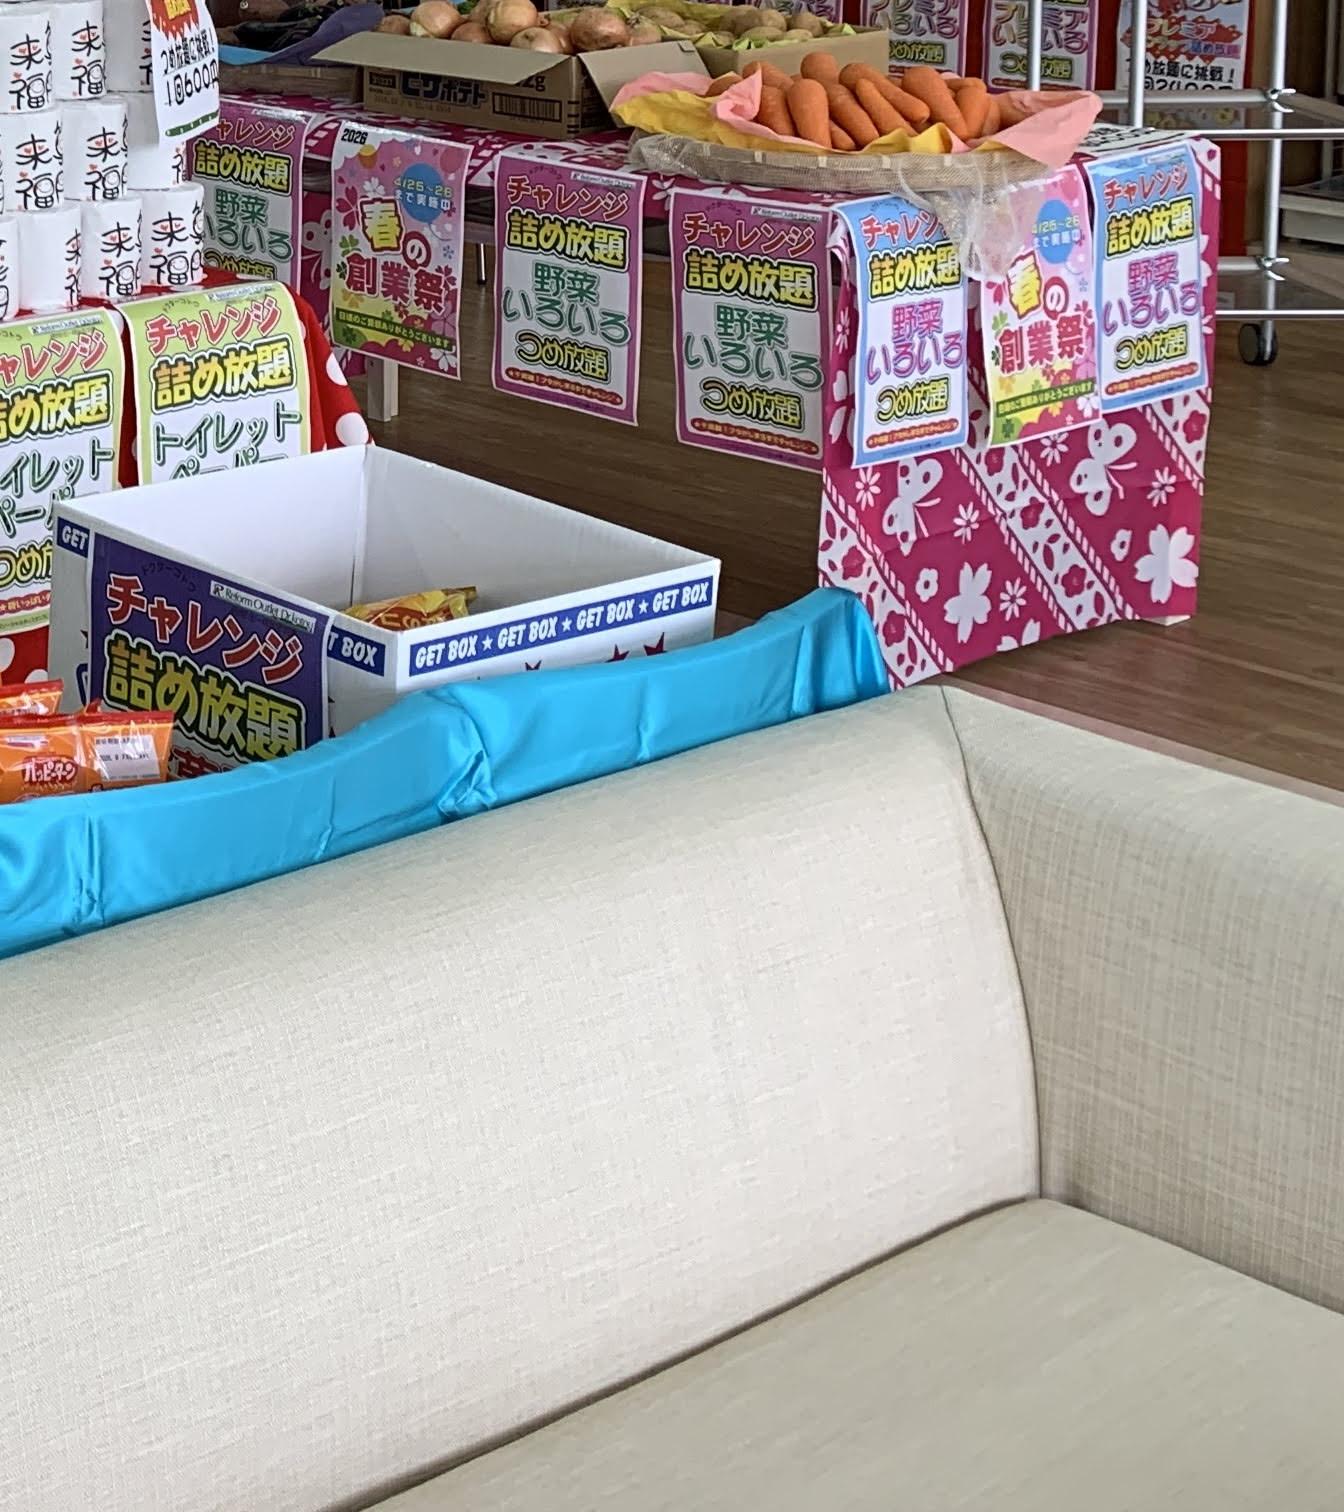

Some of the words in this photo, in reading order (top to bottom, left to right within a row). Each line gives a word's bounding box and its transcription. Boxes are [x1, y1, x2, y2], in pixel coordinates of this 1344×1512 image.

[340, 128, 369, 145] 2026
[506, 175, 629, 222] チャレンジ
[346, 253, 445, 314] 創業祭
[533, 261, 599, 304] 野菜
[715, 303, 789, 345] 野菜
[1103, 280, 1200, 336] いろいろ
[999, 314, 1087, 375] 創業祭
[107, 575, 304, 685] チャレンジ
[415, 642, 444, 668] GET
[448, 635, 479, 660] BOX
[497, 624, 526, 650] GET
